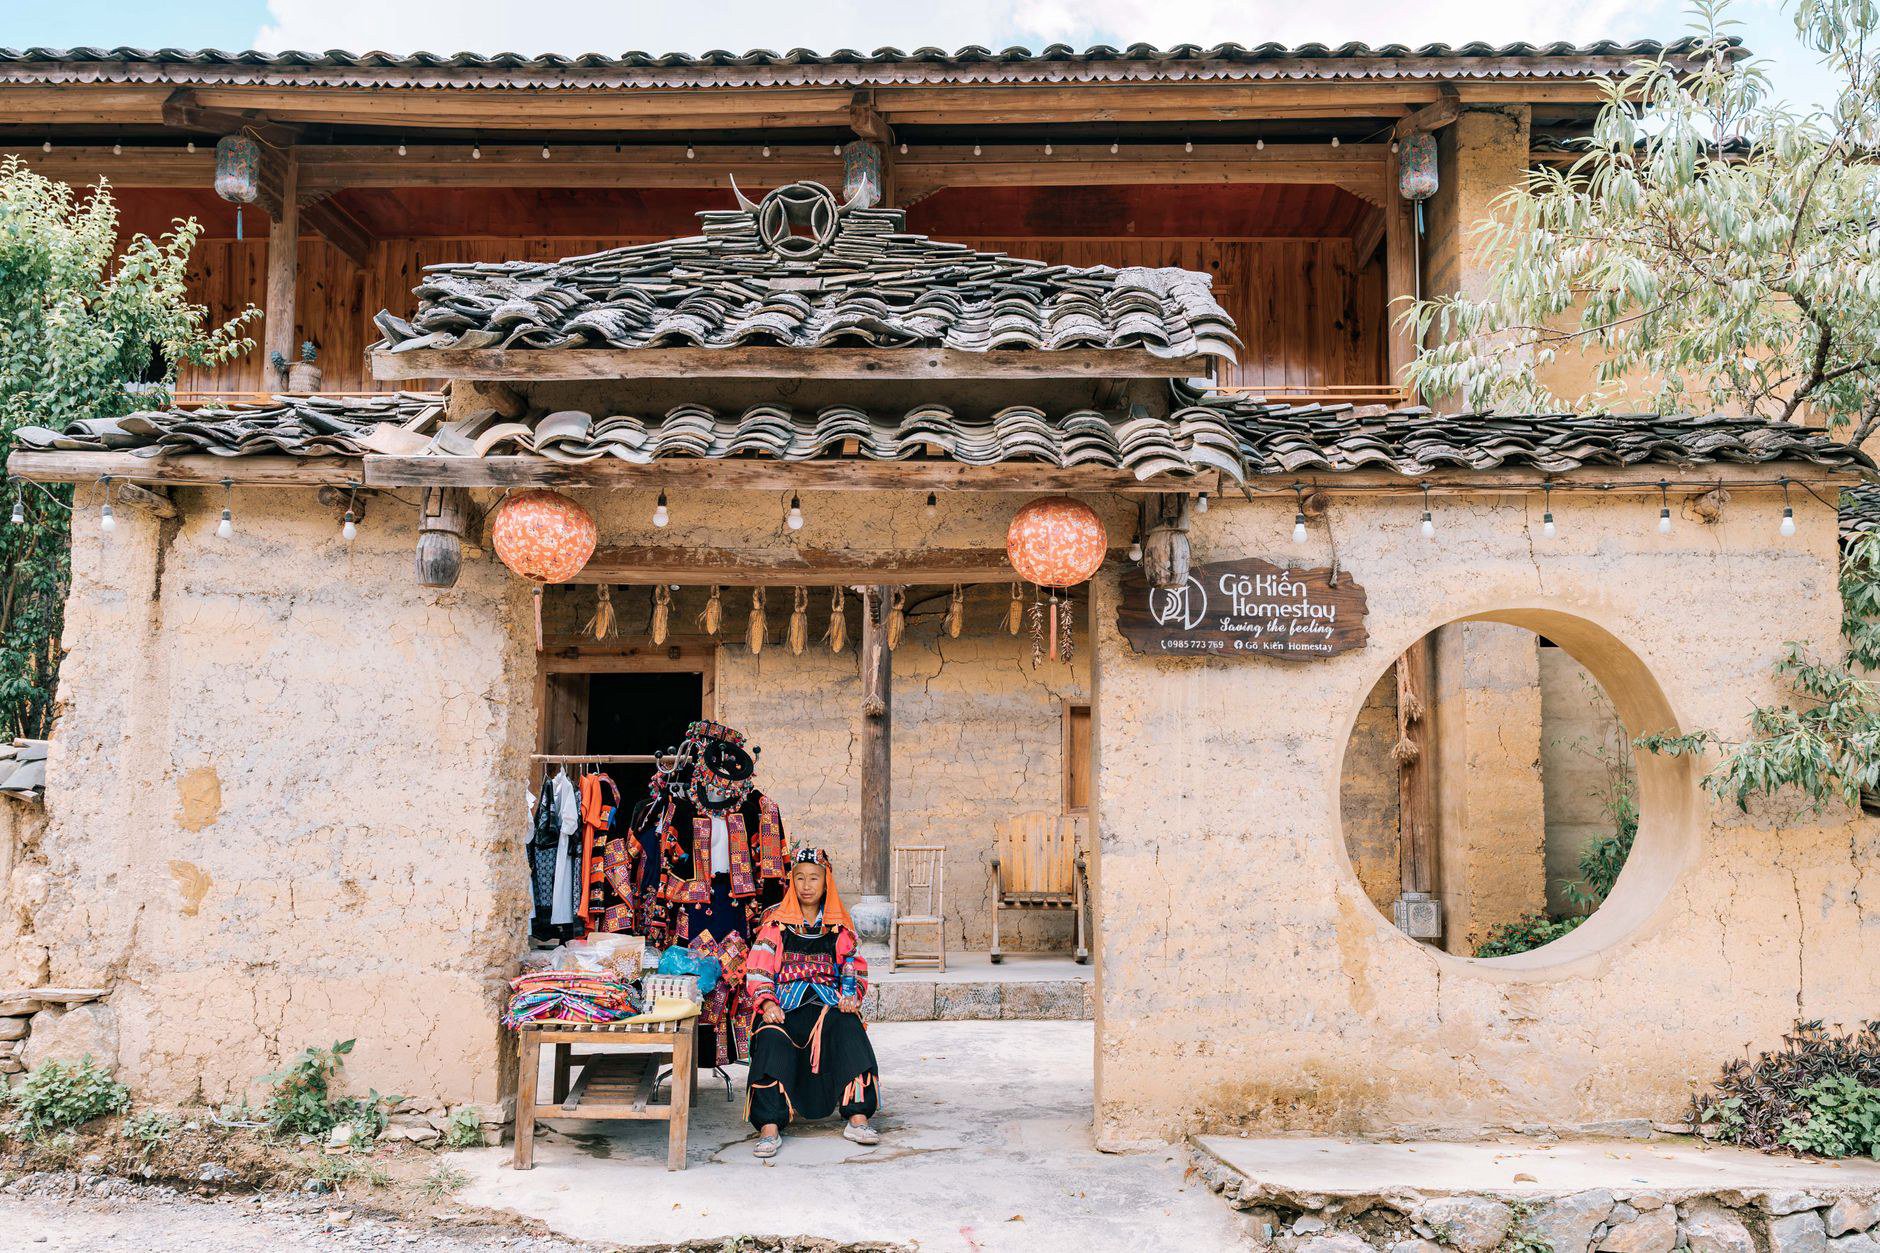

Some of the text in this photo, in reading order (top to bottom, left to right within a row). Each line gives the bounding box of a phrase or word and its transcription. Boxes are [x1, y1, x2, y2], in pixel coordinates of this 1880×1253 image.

[1219, 570, 1307, 598] Gõ Kiến
[1233, 597, 1336, 623] Homestay
[1219, 617, 1335, 639] Saving the feeling
[1245, 641, 1259, 650] Gõ
[1288, 642, 1333, 652] Homestay
